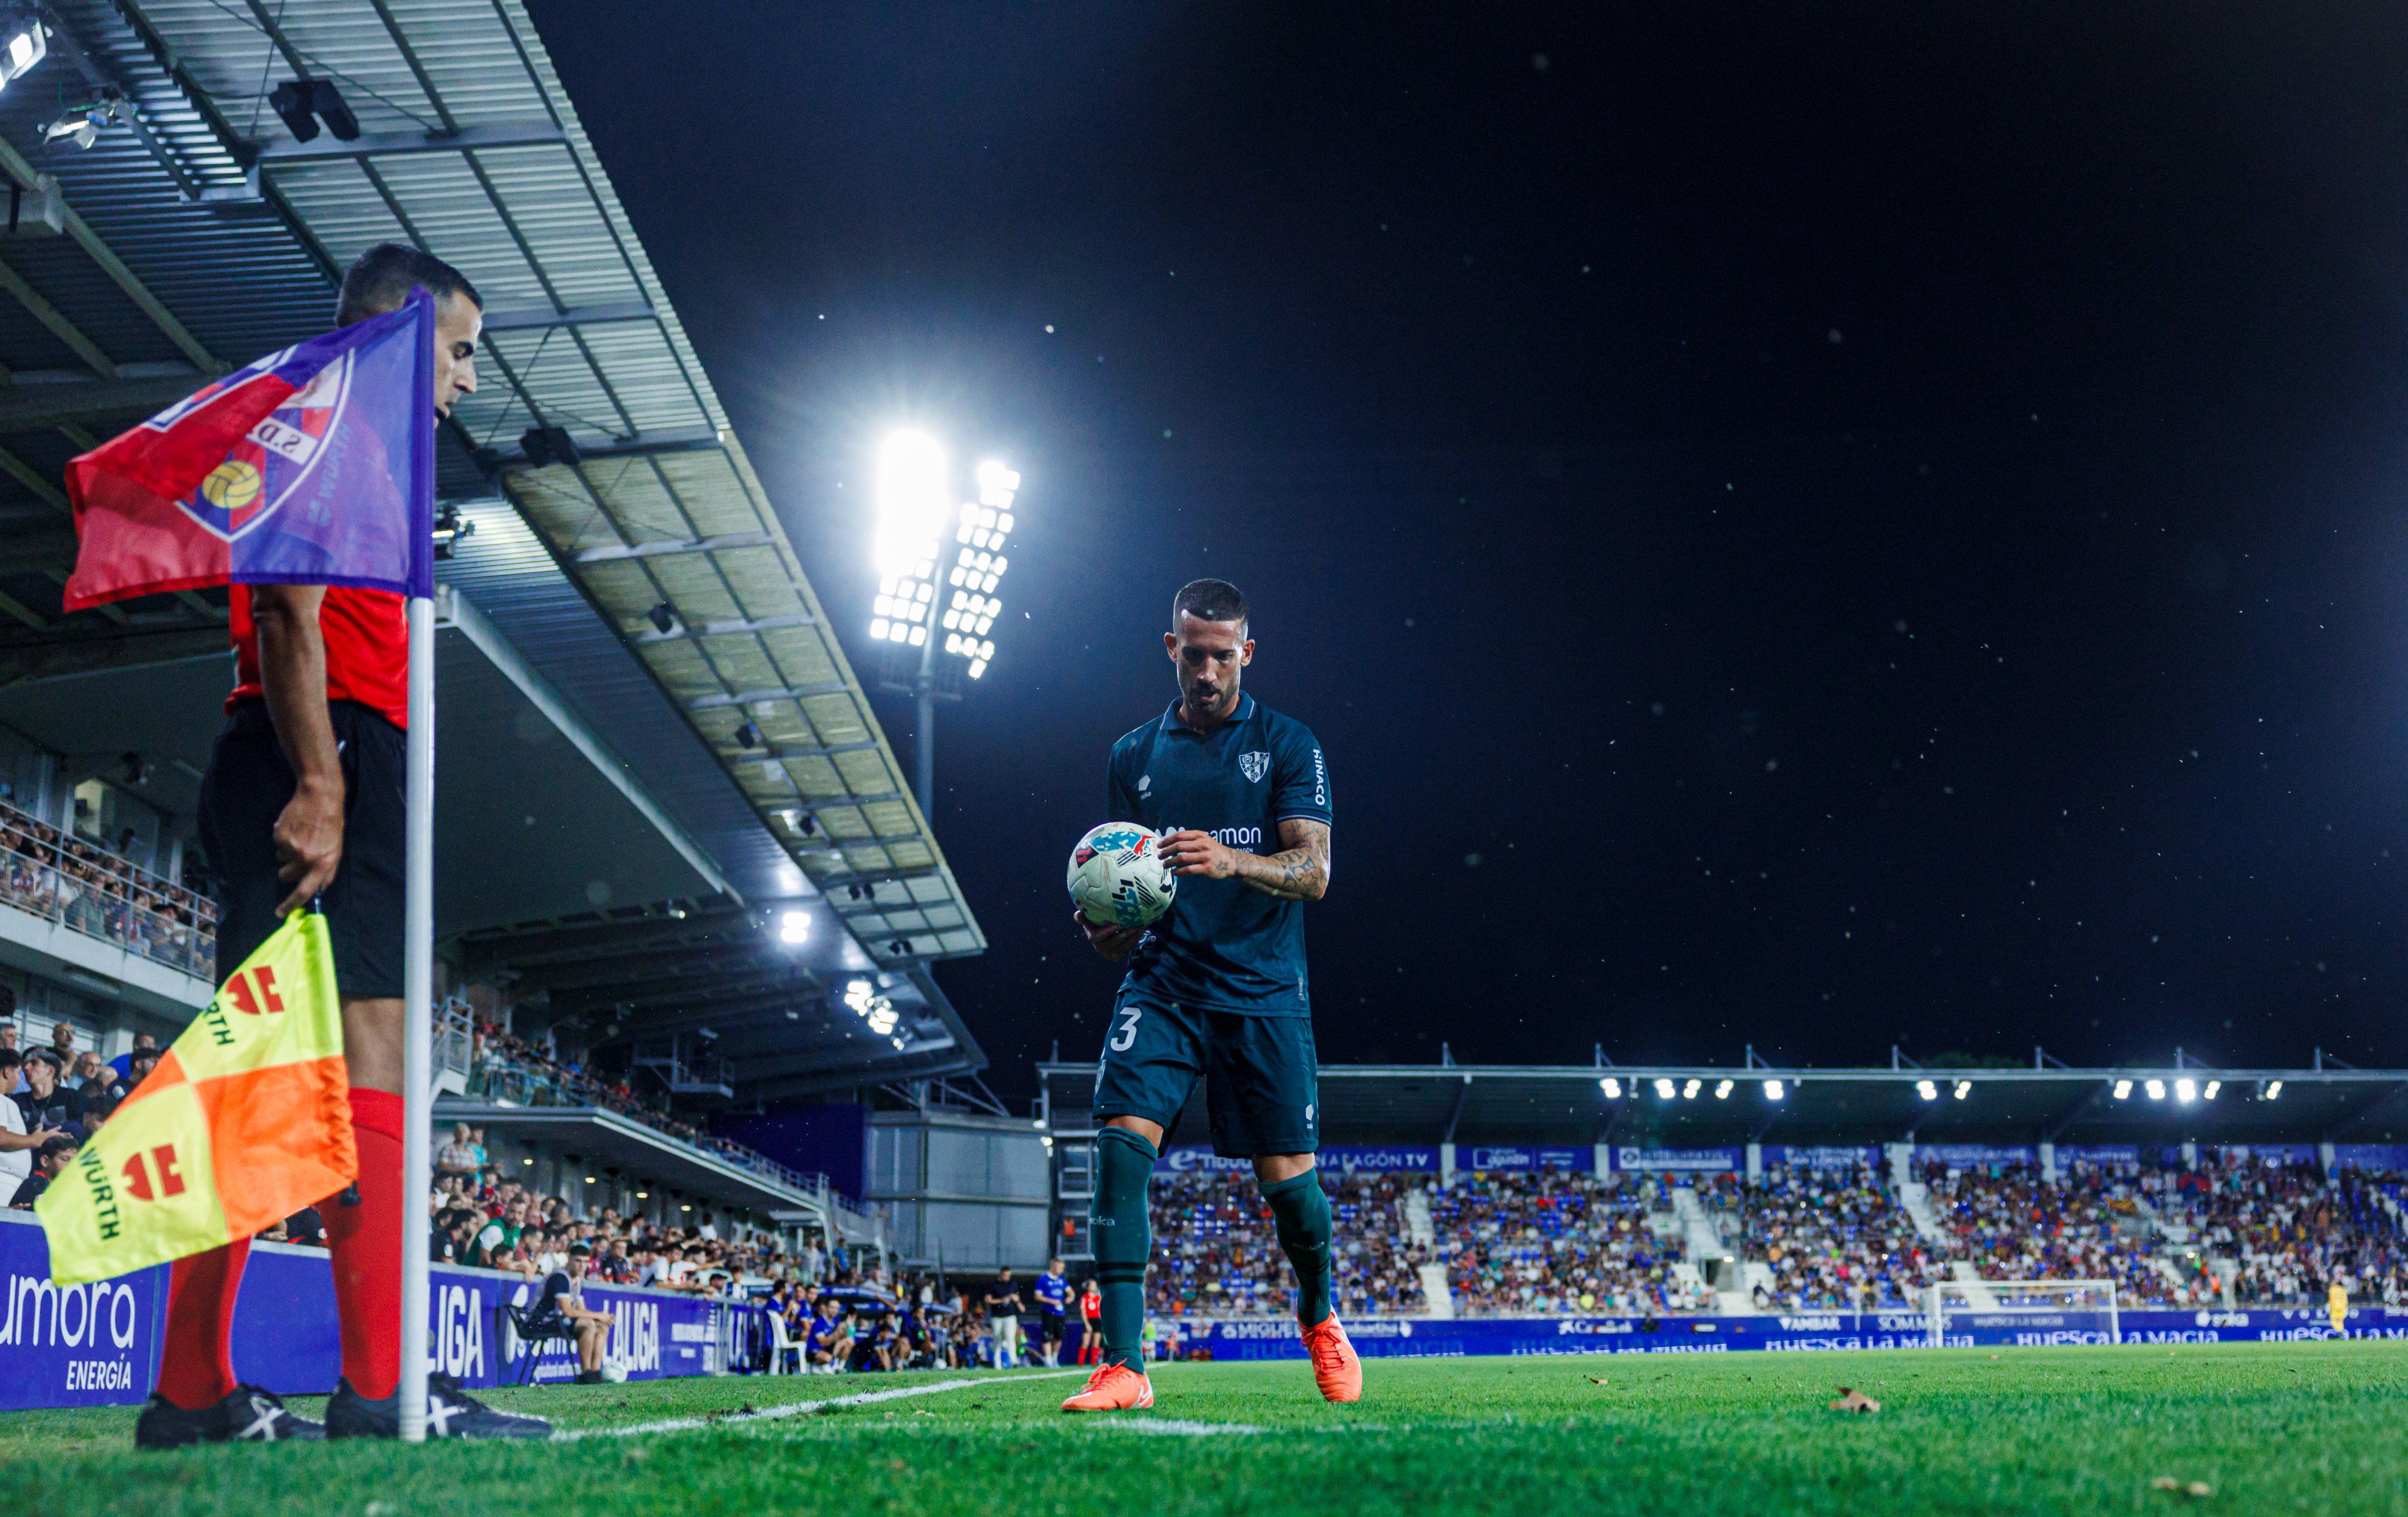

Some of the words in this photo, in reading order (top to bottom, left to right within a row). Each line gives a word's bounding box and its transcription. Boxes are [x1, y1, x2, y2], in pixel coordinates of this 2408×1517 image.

[204, 1001, 235, 1046] RTH
[1110, 1007, 1142, 1051] 3
[602, 1299, 660, 1372] LALIGA
[66, 1353, 131, 1391] ENERGÍA
